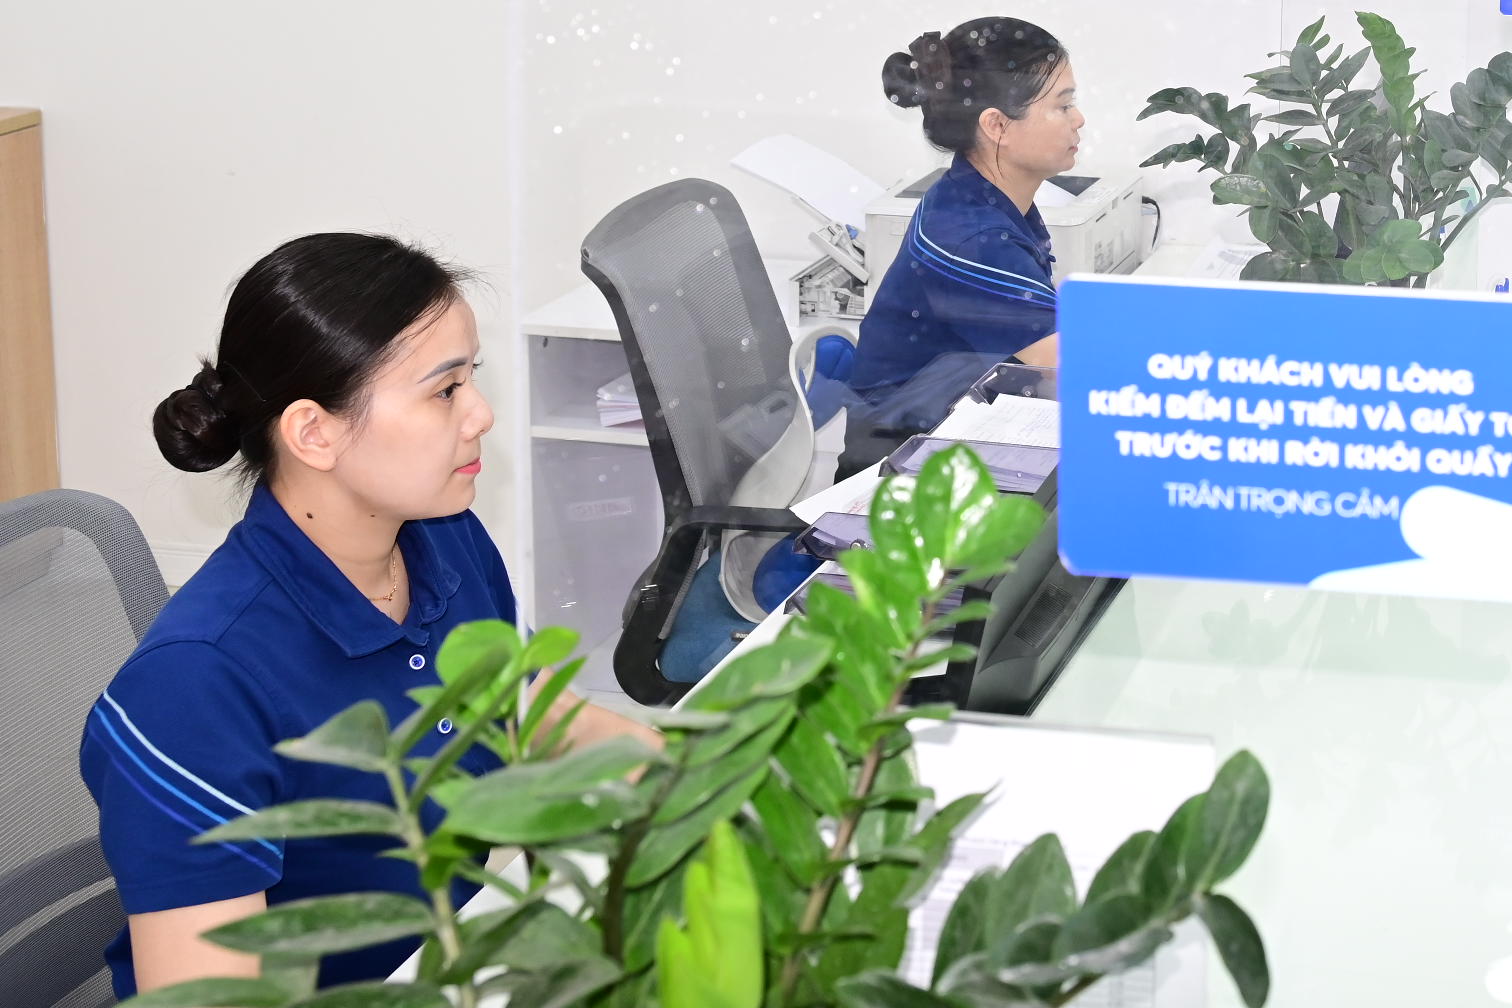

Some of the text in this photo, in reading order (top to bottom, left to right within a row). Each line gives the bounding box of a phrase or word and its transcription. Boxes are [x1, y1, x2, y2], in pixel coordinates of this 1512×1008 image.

[1147, 349, 1474, 395] QUÝ KHÁCH VUI LÒNG
[1164, 388, 1232, 422] ĐẾM
[1236, 397, 1285, 430] LẠI
[1361, 400, 1408, 432] VÀ
[1410, 402, 1485, 437] GIẤY
[1114, 428, 1223, 461] TRƯỚC
[1227, 437, 1280, 465] KHI
[1284, 435, 1340, 468] RỜI
[1344, 440, 1421, 473] KHỎI
[1164, 479, 1400, 521] TRÂN TRỌNG CẢM
